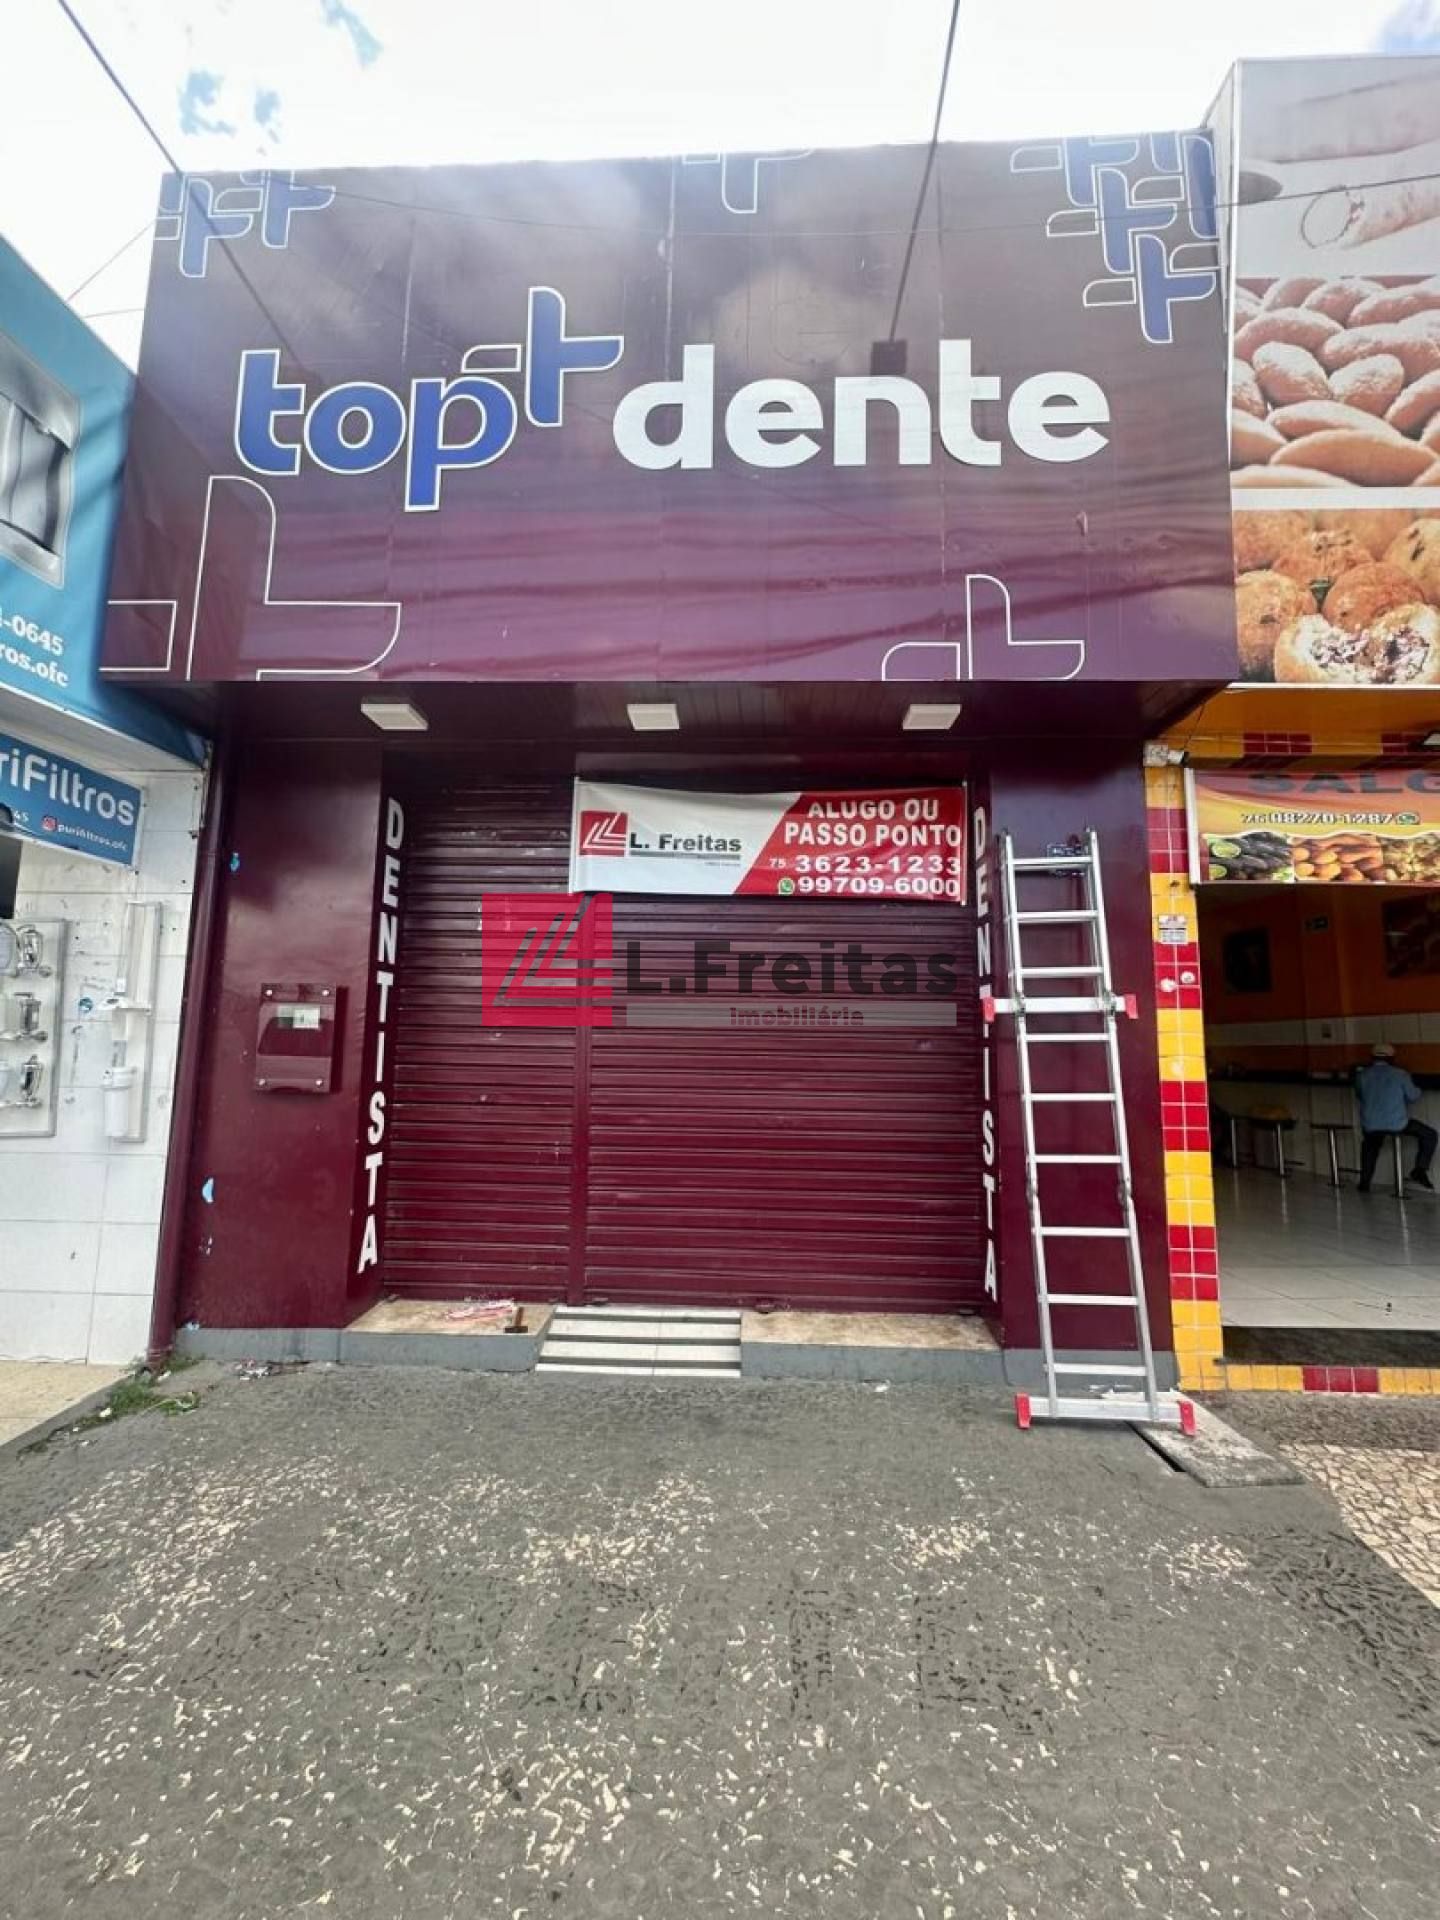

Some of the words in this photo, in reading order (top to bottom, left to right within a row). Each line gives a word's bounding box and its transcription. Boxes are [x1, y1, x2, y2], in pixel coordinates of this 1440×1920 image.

[612, 338, 1112, 470] dente
[808, 799, 896, 820] ALUGO
[904, 799, 939, 821] OU
[630, 832, 650, 849] L.
[659, 833, 742, 852] Freitas
[784, 822, 867, 846] PASSO
[875, 824, 962, 847] PONTO
[795, 854, 961, 875] 3623-1233
[797, 876, 961, 896] 99709-6000
[357, 797, 405, 1274] DENTISTA
